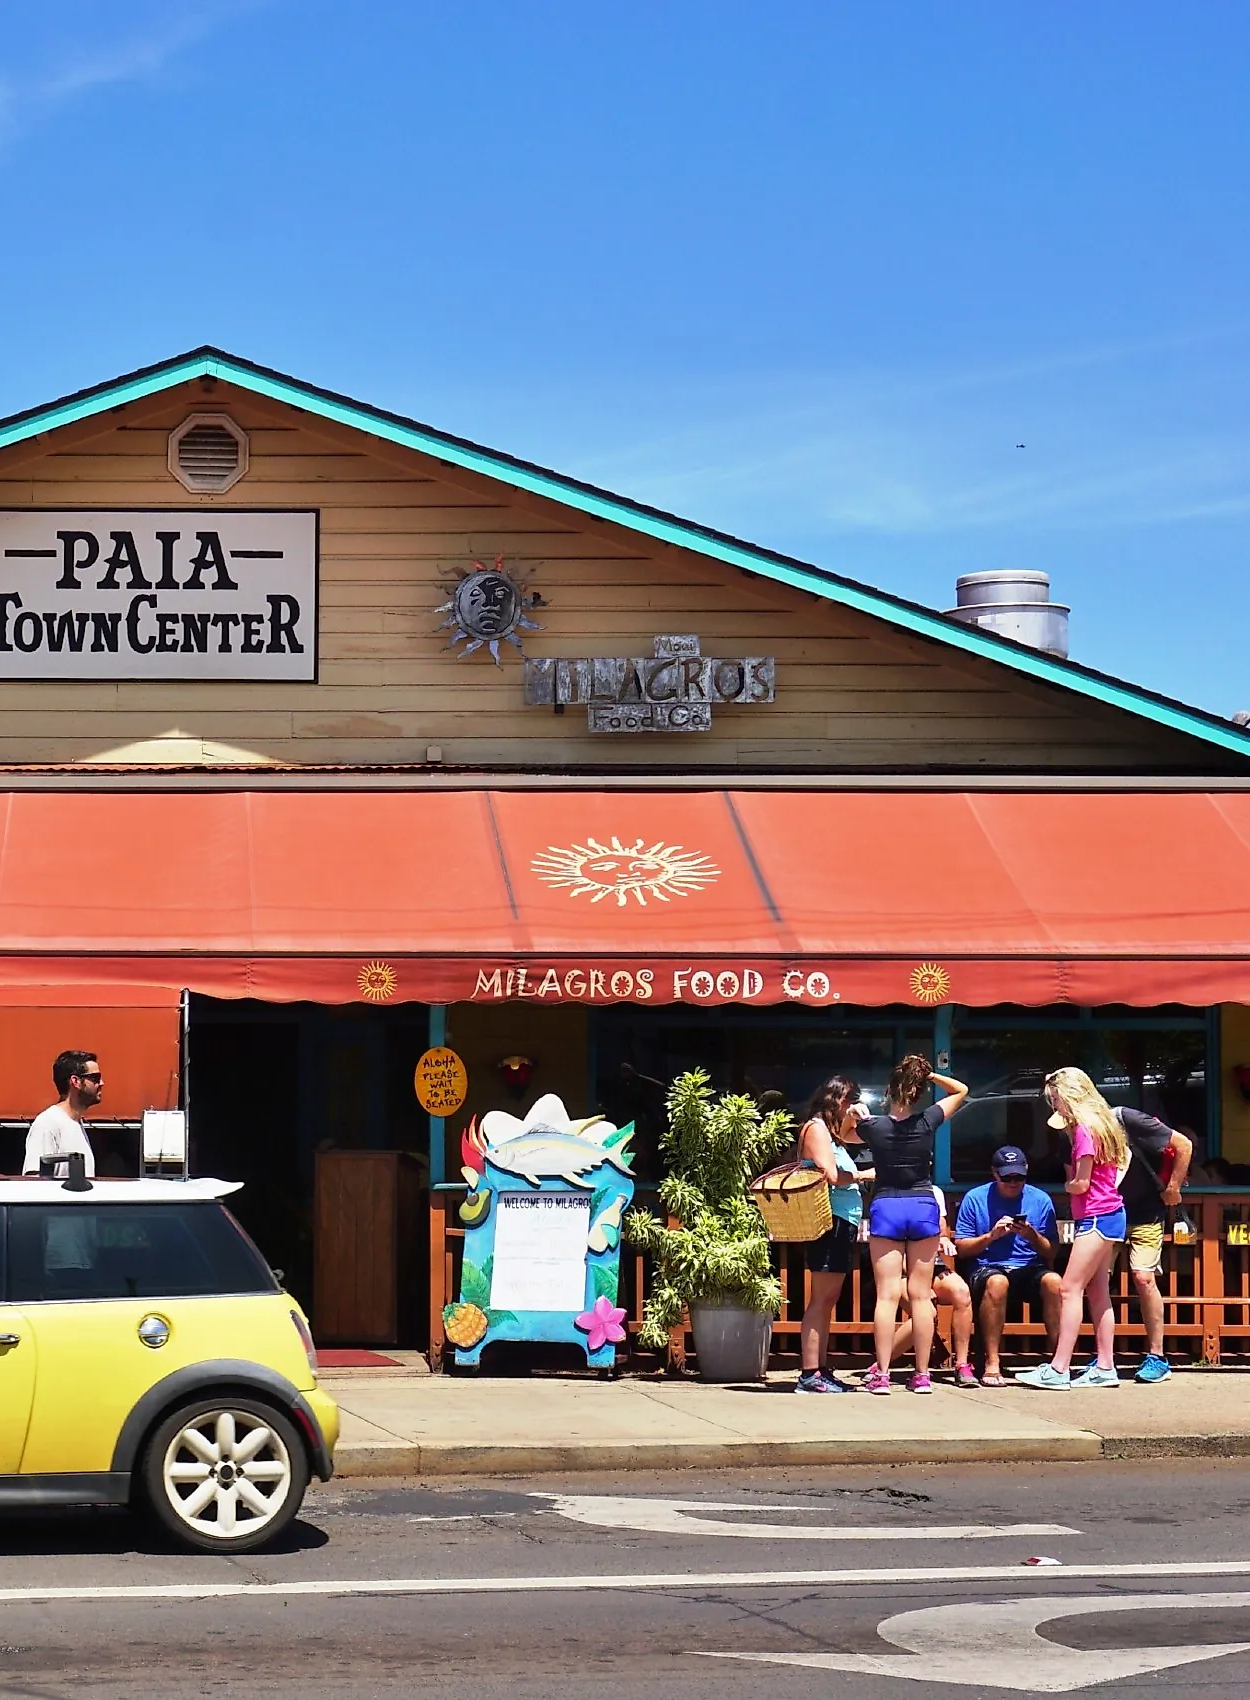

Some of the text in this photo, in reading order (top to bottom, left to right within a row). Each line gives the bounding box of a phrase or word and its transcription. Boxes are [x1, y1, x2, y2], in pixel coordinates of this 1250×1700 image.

[55, 530, 239, 591] PAIA
[656, 637, 697, 653] Maui
[529, 658, 771, 702] MILAGROS
[589, 704, 654, 728] Food
[470, 966, 841, 1000] MILAGROS FOOD CO.
[423, 1055, 456, 1069] ALOHA
[422, 1069, 460, 1081] PLEASE
[430, 1079, 453, 1089] WAIT
[427, 1089, 457, 1098] TO BE
[425, 1098, 462, 1109] SEATED
[503, 1197, 540, 1209] WELCOME
[543, 1197, 553, 1209] TO
